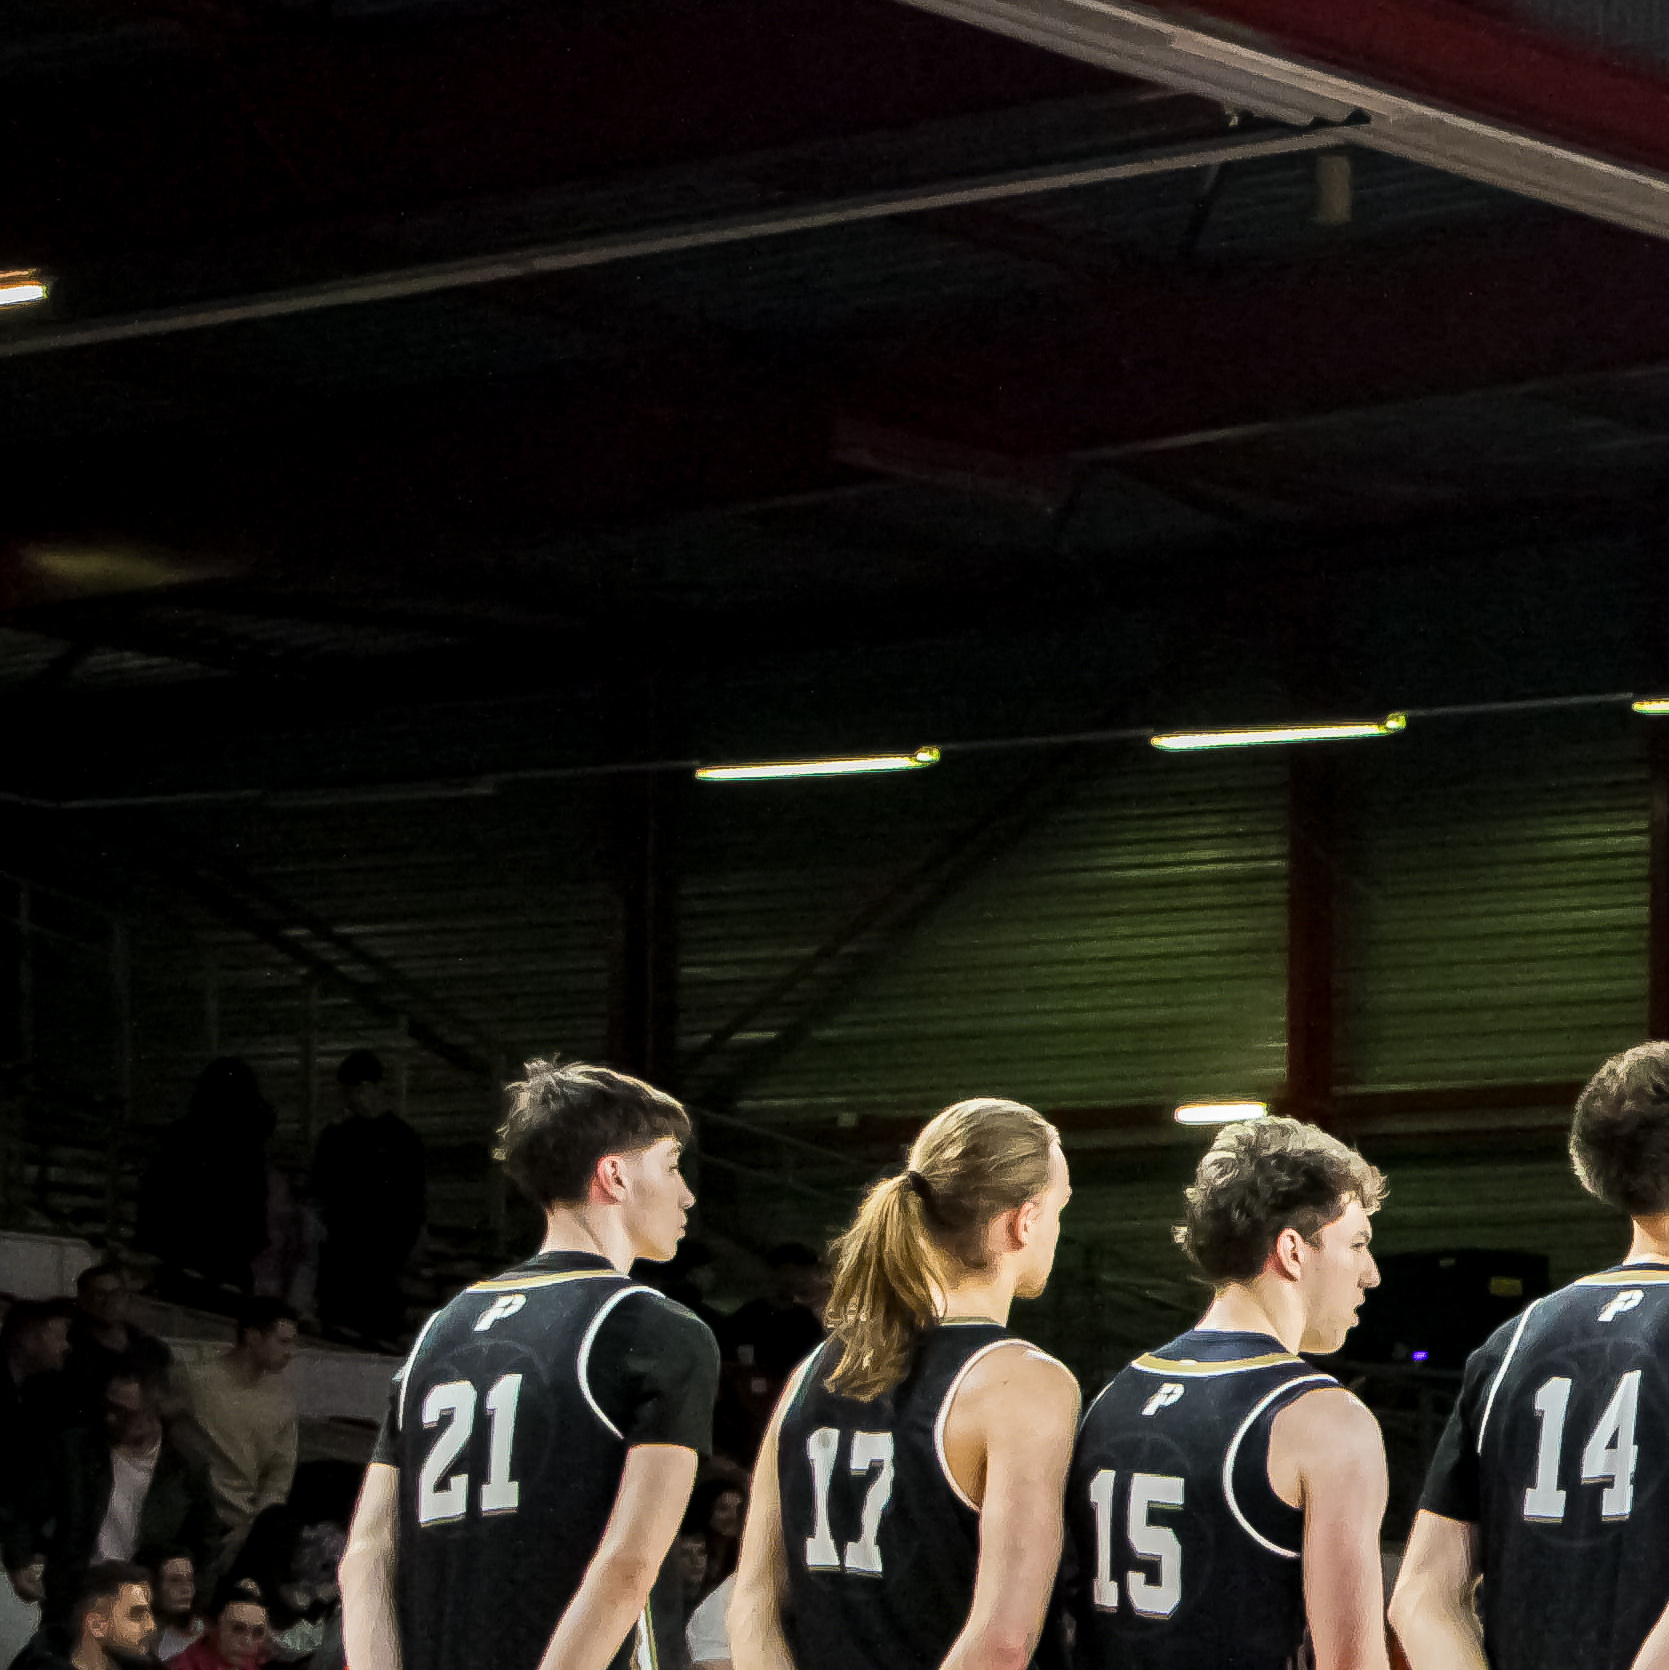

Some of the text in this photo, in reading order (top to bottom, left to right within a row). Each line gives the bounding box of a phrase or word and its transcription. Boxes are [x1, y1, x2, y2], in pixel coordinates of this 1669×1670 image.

[419, 1374, 521, 1526] 21
[806, 1428, 894, 1576] 17
[1523, 1370, 1642, 1524] 14
[1089, 1470, 1185, 1619] 15
